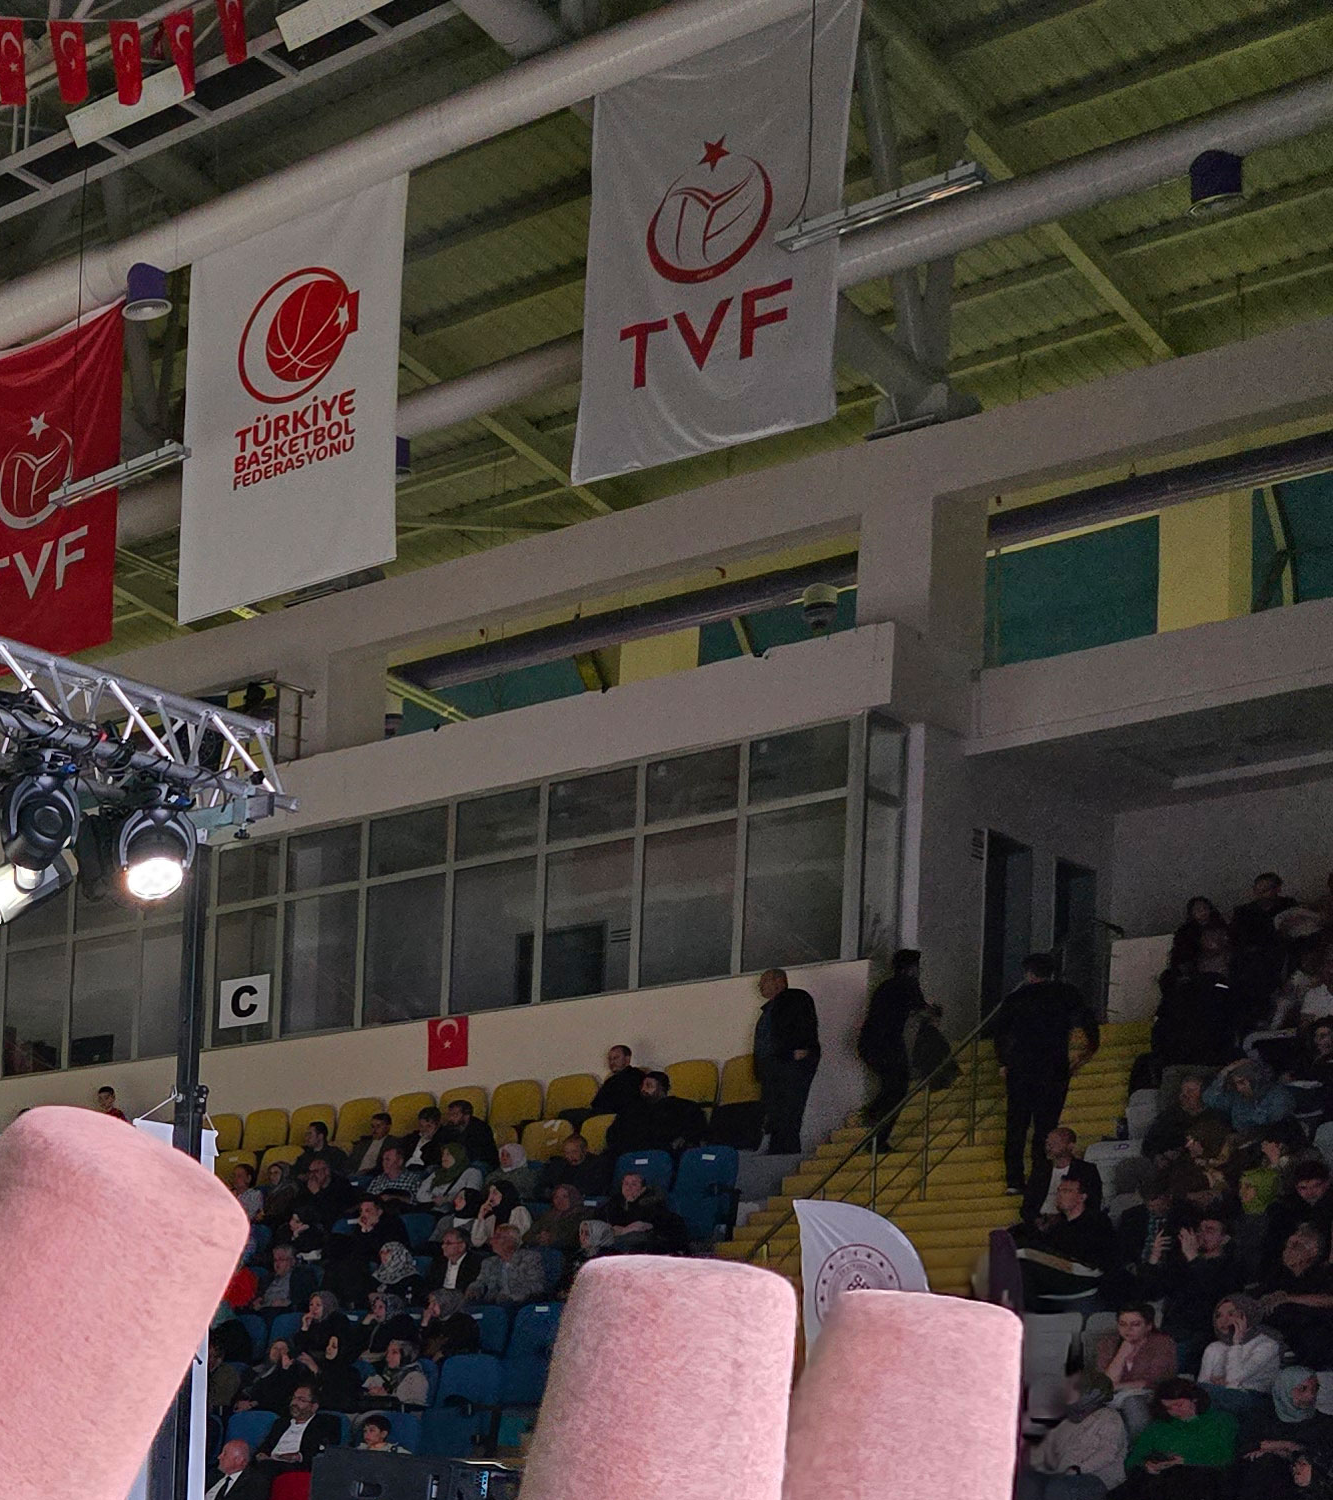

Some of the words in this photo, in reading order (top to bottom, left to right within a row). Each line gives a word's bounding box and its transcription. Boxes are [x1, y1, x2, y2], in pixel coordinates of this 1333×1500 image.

[619, 277, 793, 390] TVF
[234, 388, 356, 453] TÜRKİYE
[234, 417, 356, 474] BASKETBOL
[233, 436, 355, 491] FEDERASYONU
[230, 984, 259, 1018] C
